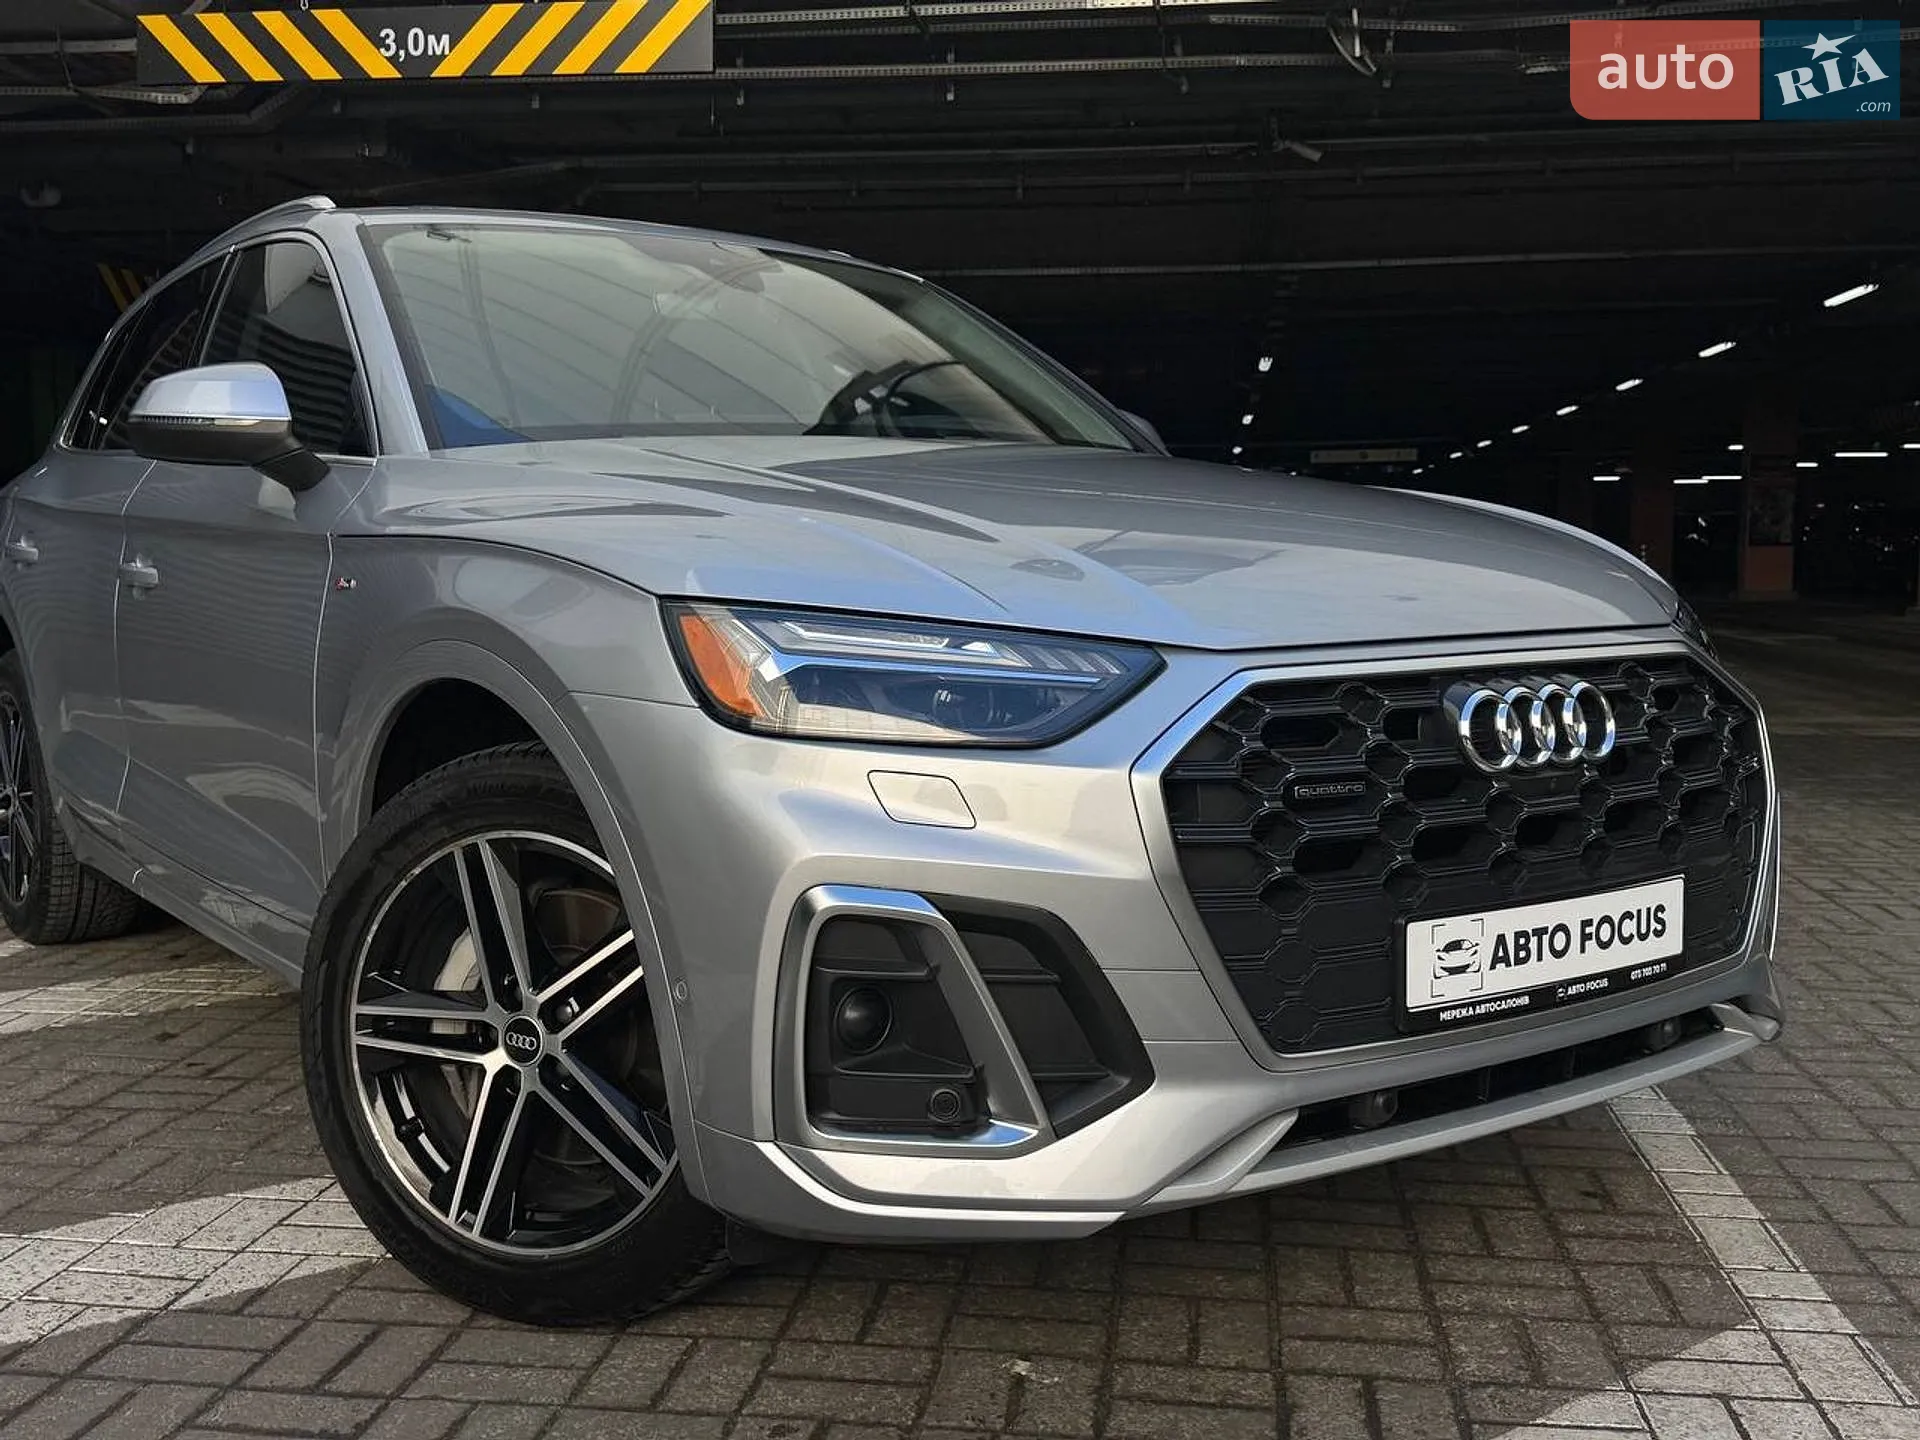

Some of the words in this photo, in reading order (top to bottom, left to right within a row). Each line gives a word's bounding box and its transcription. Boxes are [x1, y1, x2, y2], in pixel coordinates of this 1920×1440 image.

[1298, 784, 1364, 797] quattro
[1489, 923, 1572, 971] АВТО
[1579, 903, 1667, 955] FOCUS
[1586, 977, 1609, 992] FOCUS
